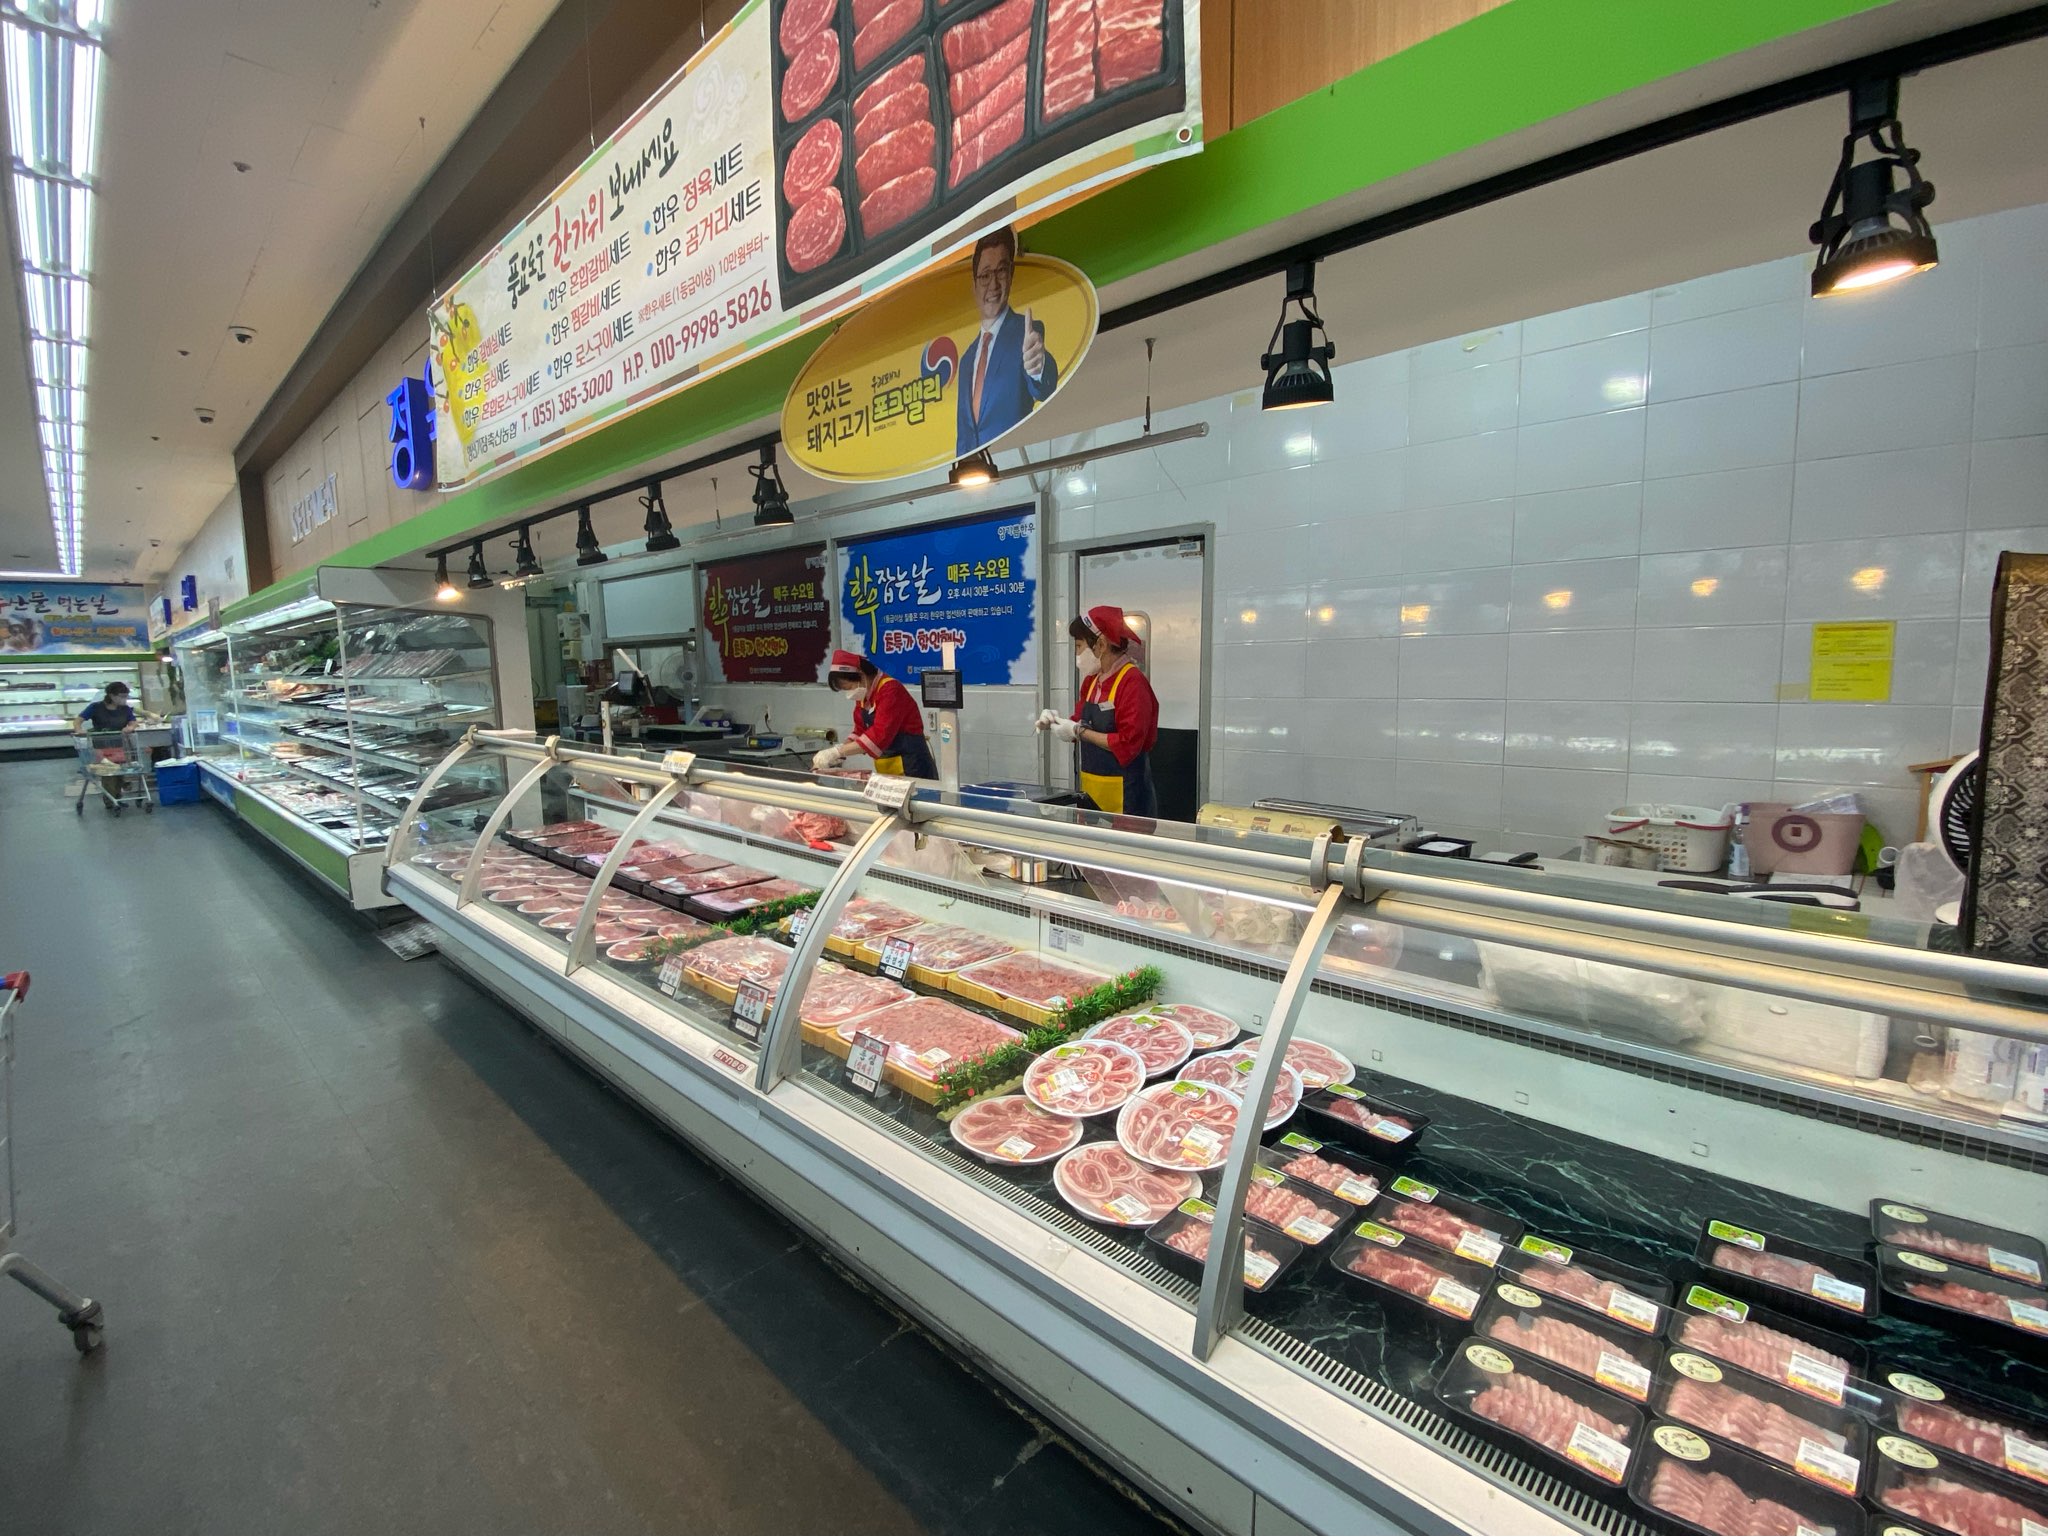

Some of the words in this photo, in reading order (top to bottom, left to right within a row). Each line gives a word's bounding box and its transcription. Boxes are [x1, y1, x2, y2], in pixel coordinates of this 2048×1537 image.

[507, 233, 546, 310] 풍요로운
[548, 187, 604, 273] 한가위
[609, 118, 679, 221] 보내세요
[653, 194, 679, 235] 한우
[682, 142, 744, 212] 정육세트
[656, 238, 681, 276] 한우
[685, 179, 762, 257] 곰거리세트
[548, 281, 567, 311] 한우
[570, 231, 631, 296] 혼합갈비세트
[552, 316, 570, 345] 한우
[571, 279, 622, 332] 찜갈비세트
[467, 349, 480, 373] 한우
[479, 321, 512, 363] 갈비살세트
[521, 412, 531, 433] T.
[533, 399, 555, 427] 055)
[558, 369, 613, 415] 385-3000
[623, 351, 648, 385] H.P.
[650, 279, 772, 369] 010-9998-5826
[554, 352, 573, 380] 한우
[576, 311, 634, 368] 로스구이세트
[464, 406, 480, 428] 한우
[482, 371, 540, 421] 혼합로스구이세트
[465, 379, 481, 400] 한우
[483, 359, 511, 393] 등심세트
[807, 379, 852, 420] 맛있는
[873, 373, 942, 425] 포크밸리
[808, 405, 870, 452] 돼지고기
[791, 582, 815, 600] 수요일
[947, 563, 970, 583] 매주
[974, 557, 1010, 581] 수요일
[947, 588, 960, 599] 오후
[961, 587, 973, 598] 4시
[1009, 581, 1025, 594] 30분
[849, 555, 880, 654] 한우
[875, 555, 942, 605] 잡는날
[885, 630, 915, 654] 초특가
[917, 627, 966, 653] 할인행사
